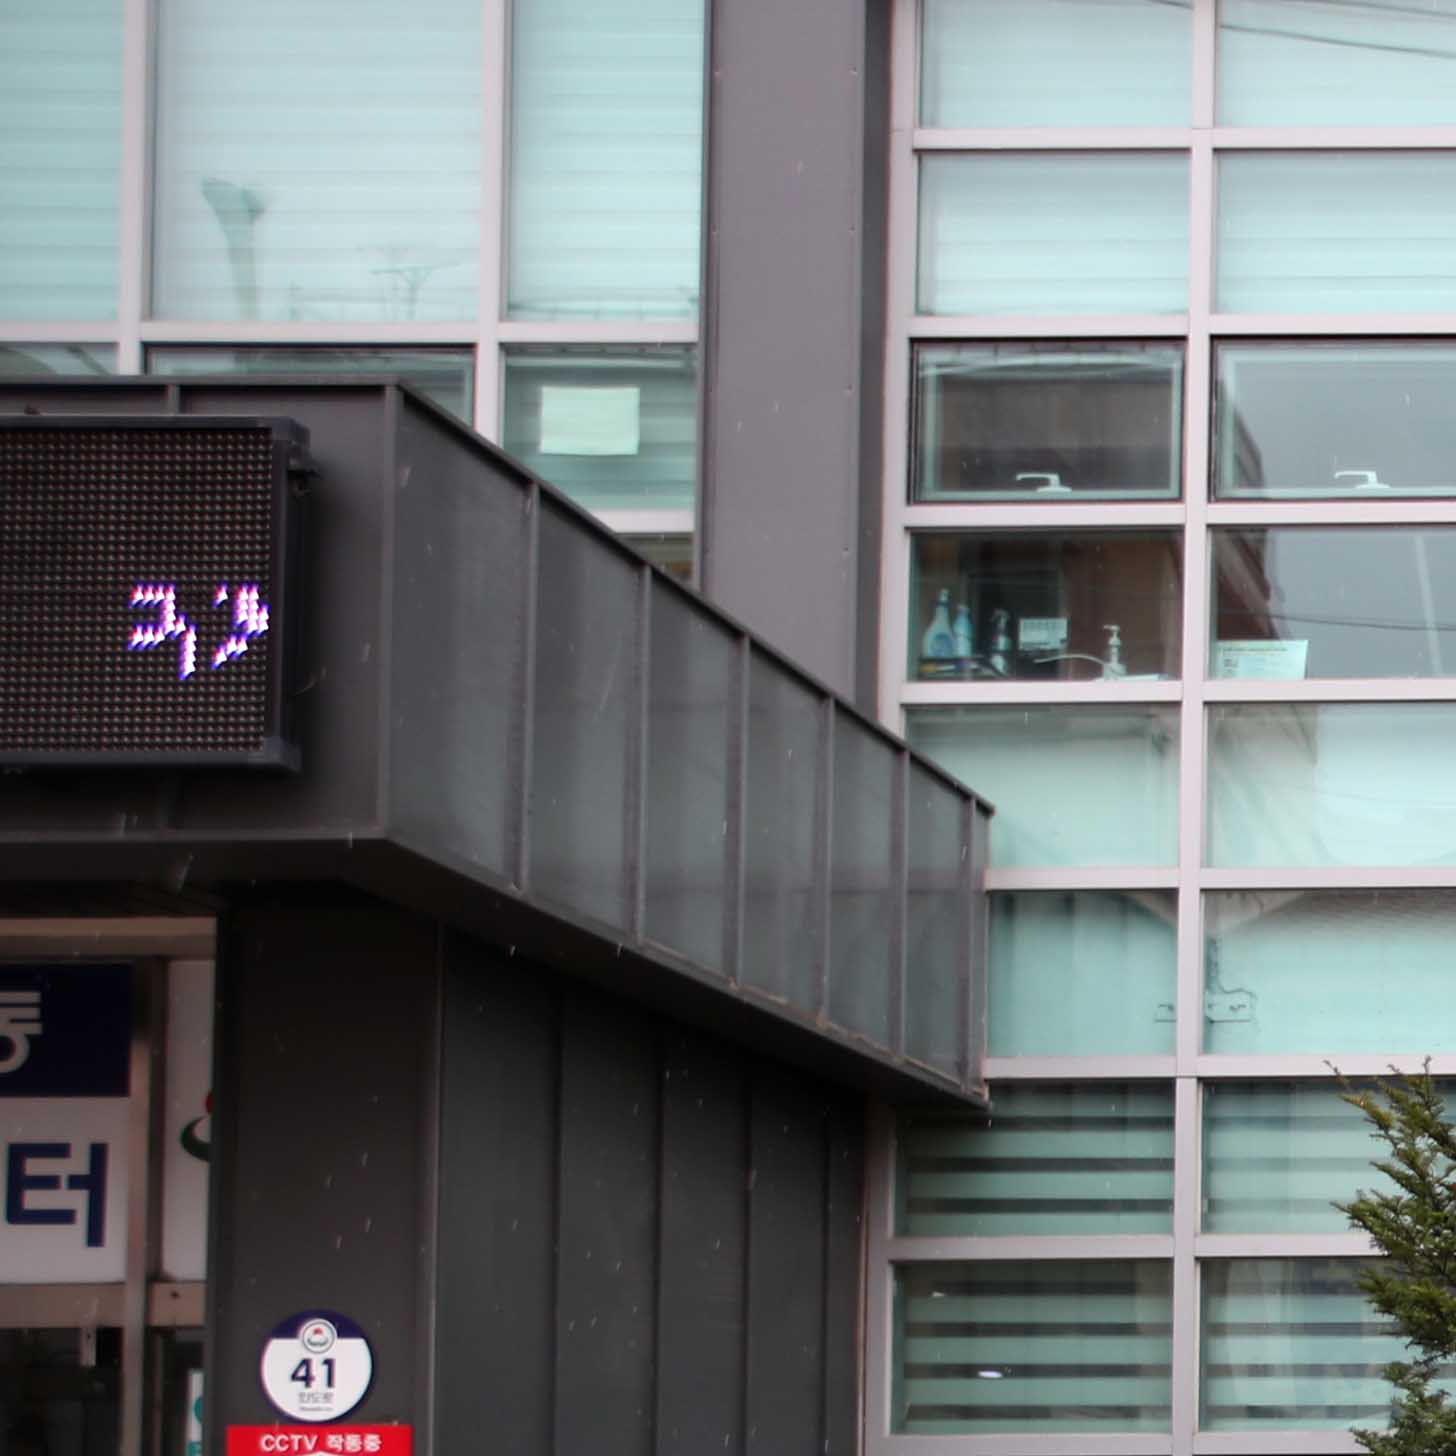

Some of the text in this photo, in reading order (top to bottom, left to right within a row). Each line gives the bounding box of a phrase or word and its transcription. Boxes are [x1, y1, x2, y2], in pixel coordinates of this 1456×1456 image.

[291, 1358, 336, 1389] 41
[260, 1434, 382, 1452] CCTV 작동중
